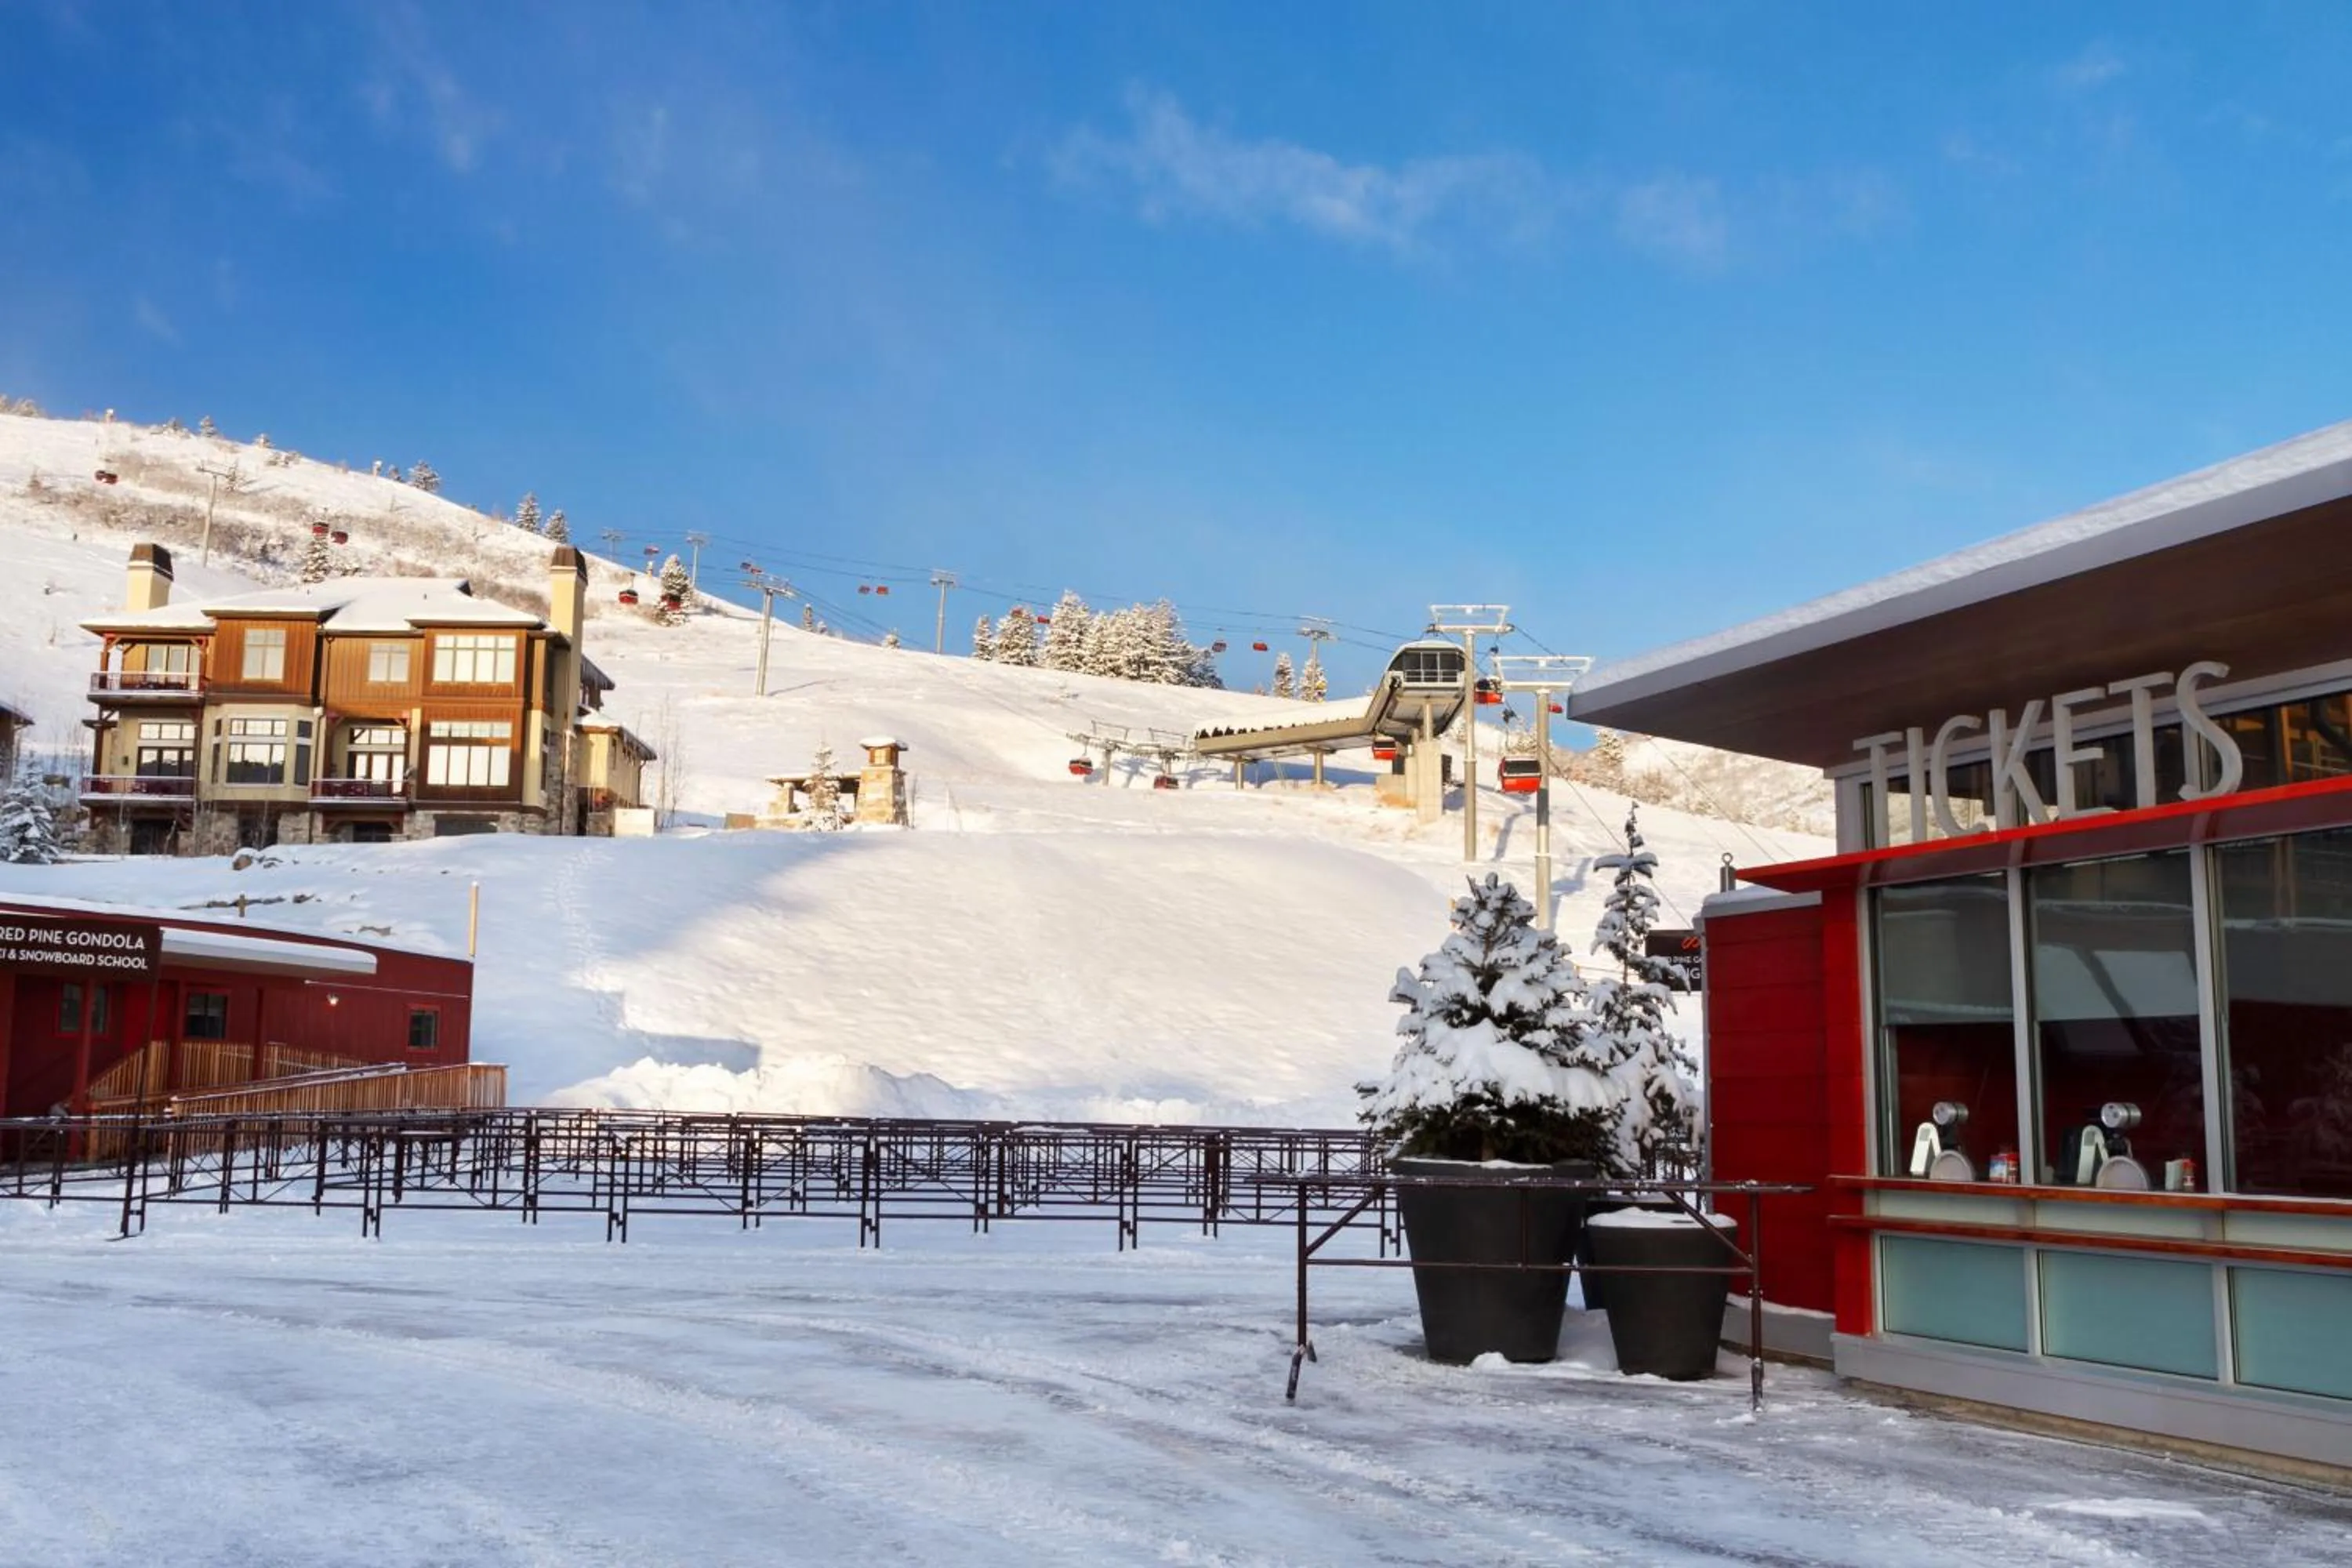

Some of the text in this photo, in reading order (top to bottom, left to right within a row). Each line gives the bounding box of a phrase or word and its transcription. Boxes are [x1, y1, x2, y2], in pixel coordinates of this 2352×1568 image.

[1853, 660, 2242, 848] TICKETS
[0, 926, 145, 949] RED PINE GONDOLA
[8, 948, 16, 960] &
[19, 949, 94, 966] SNOWBOARD
[97, 955, 148, 969] SCHOOL
